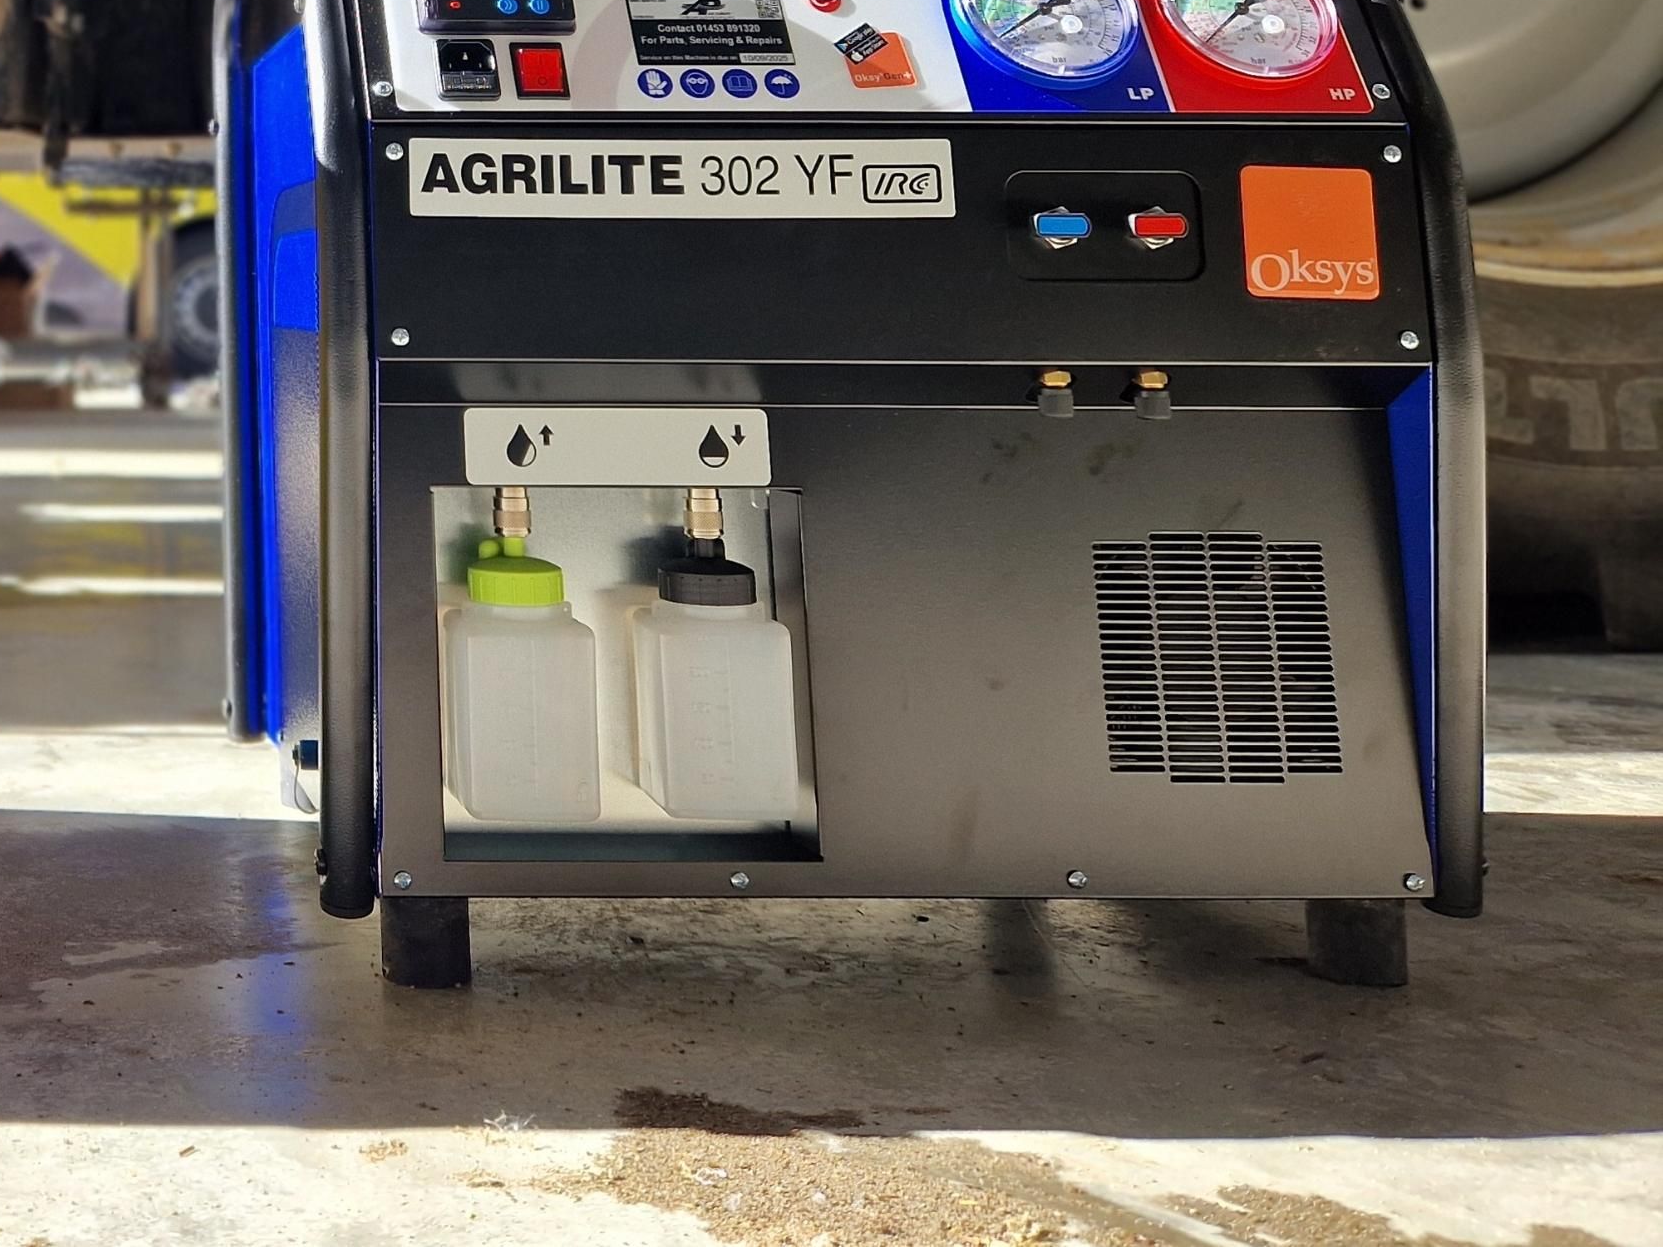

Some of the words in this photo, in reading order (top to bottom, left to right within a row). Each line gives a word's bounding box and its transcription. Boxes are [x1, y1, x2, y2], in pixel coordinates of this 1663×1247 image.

[657, 24, 695, 33] Contact
[696, 24, 725, 33] 01453
[726, 24, 761, 33] 891320
[641, 36, 657, 45] For
[659, 36, 688, 45] Parts,
[689, 36, 734, 46] Servicing
[736, 36, 744, 45] &
[745, 36, 783, 46] Repairs
[1051, 56, 1067, 64] bar
[1127, 87, 1155, 101] LP
[1329, 87, 1357, 101] HP
[421, 152, 685, 196] AGRILITE
[700, 155, 780, 196] 302
[795, 153, 855, 196] YF
